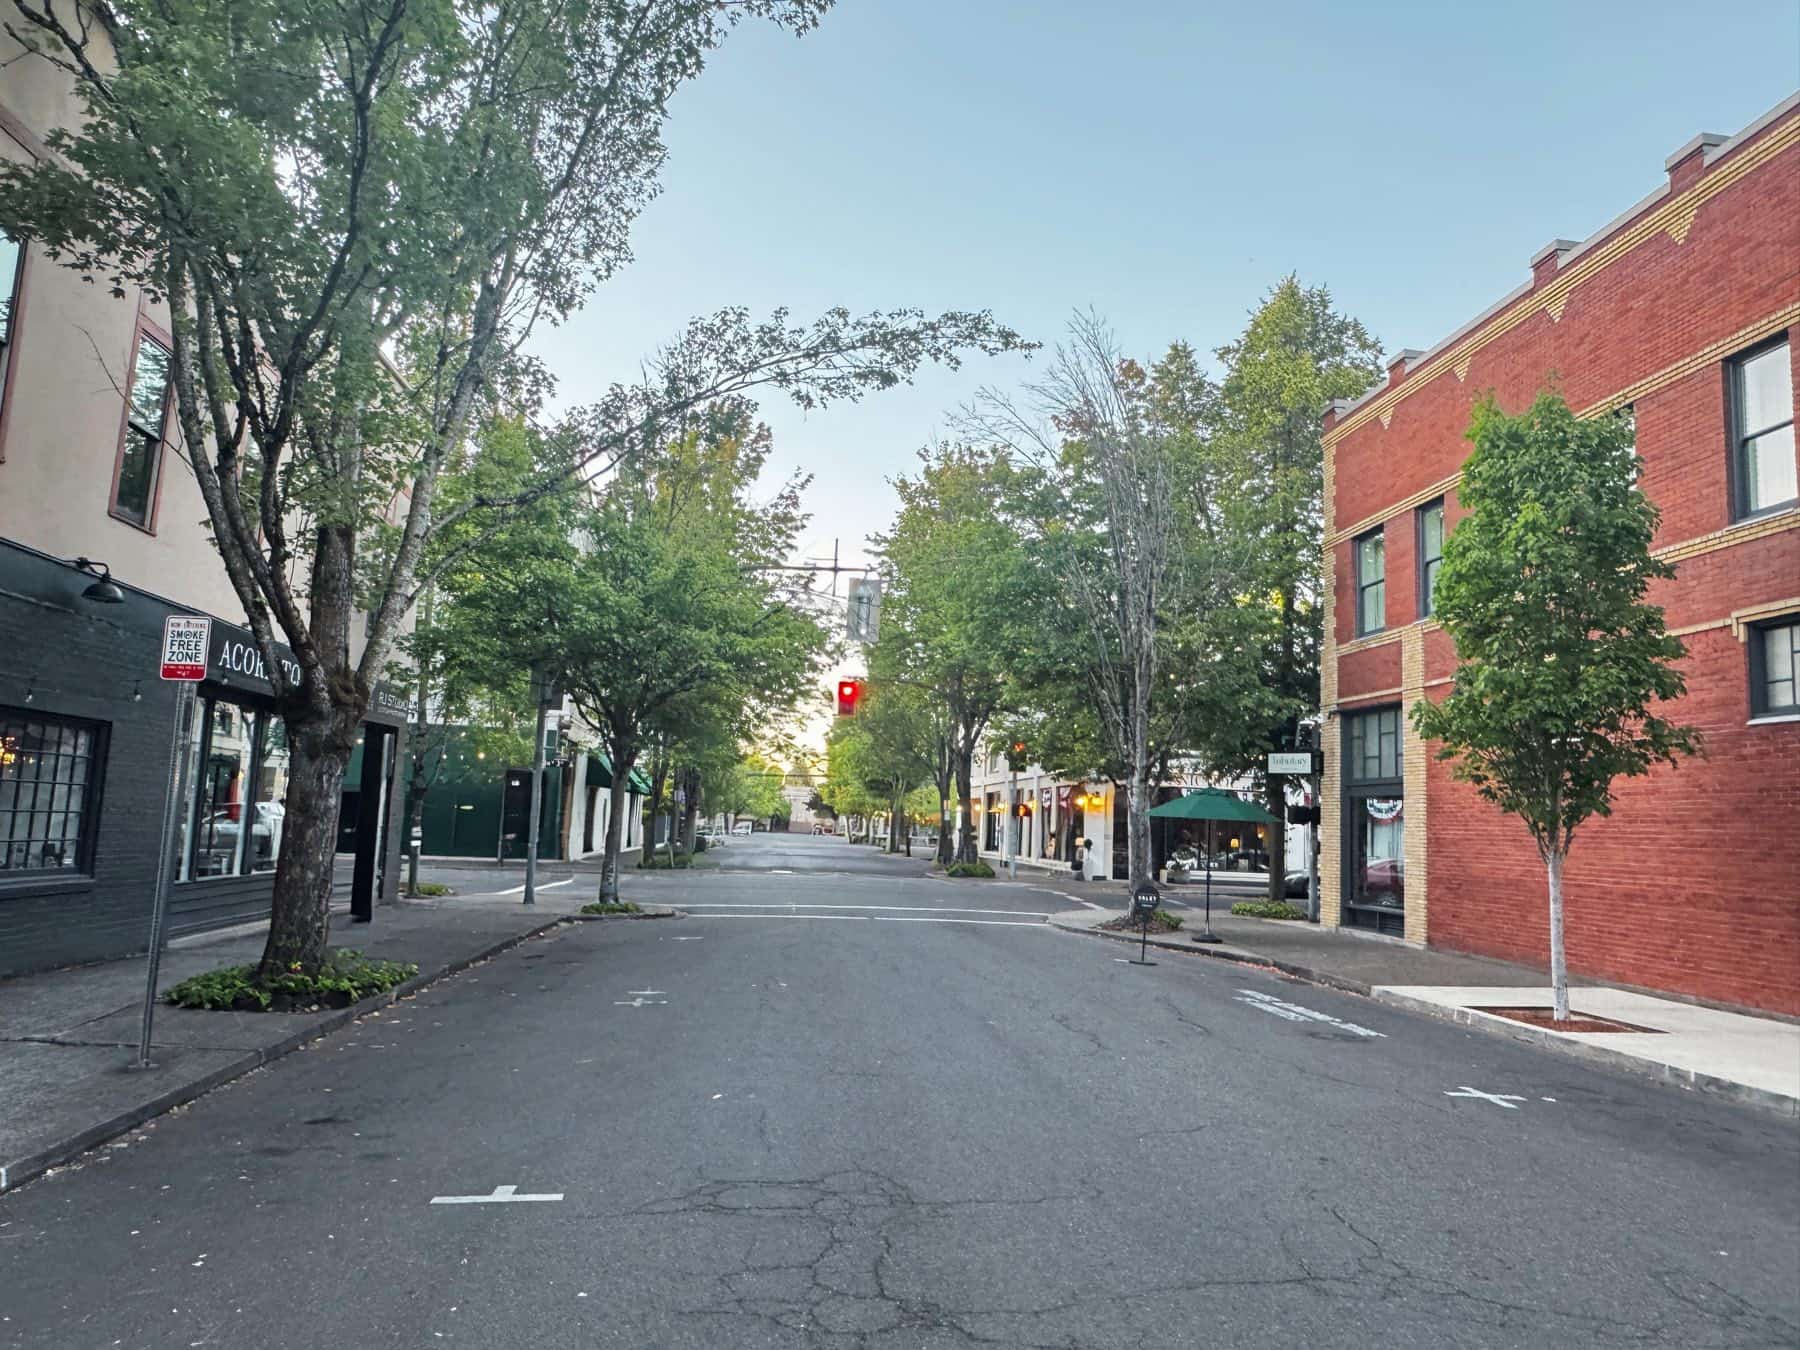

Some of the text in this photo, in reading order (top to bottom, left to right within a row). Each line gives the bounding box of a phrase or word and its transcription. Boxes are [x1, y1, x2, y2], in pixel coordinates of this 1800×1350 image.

[170, 630, 205, 640] SMOKE
[170, 640, 202, 651] FREE
[168, 651, 202, 663] ZONE
[218, 639, 270, 681] ACOR
